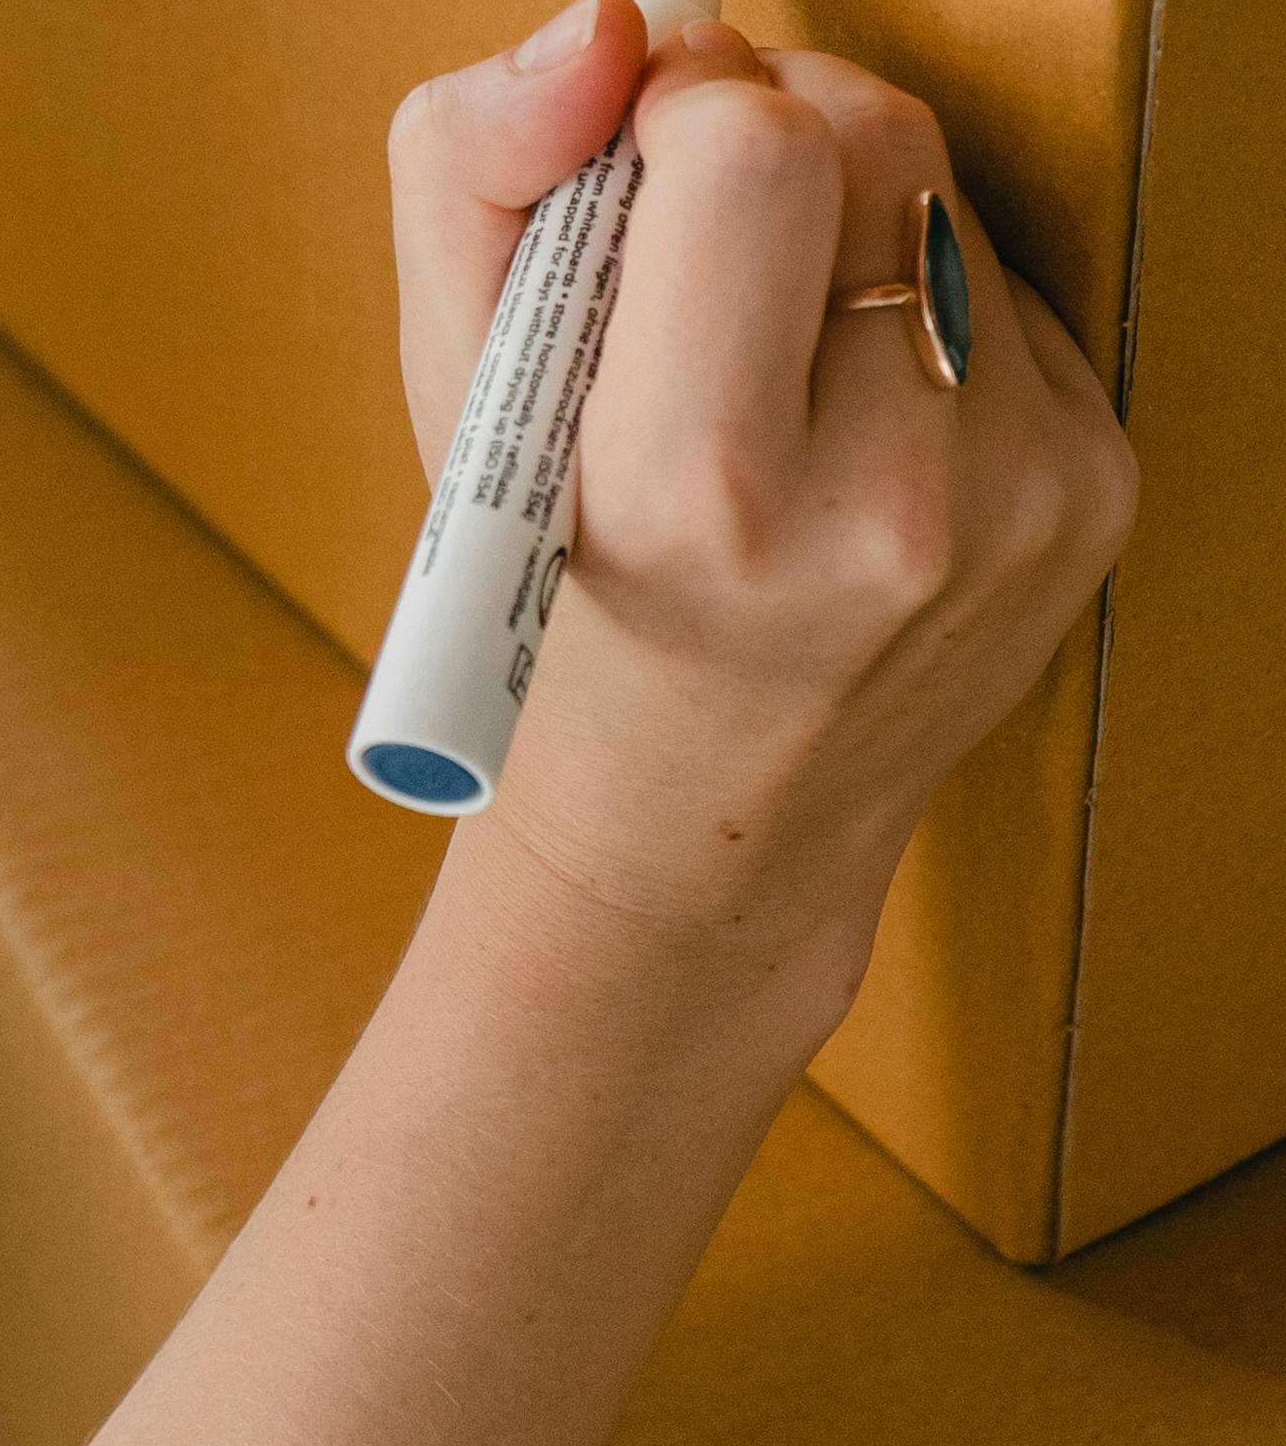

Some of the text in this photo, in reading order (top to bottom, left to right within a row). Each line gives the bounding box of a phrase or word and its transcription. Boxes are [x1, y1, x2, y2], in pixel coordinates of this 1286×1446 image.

[591, 160, 615, 197] from
[556, 170, 589, 243] uncapped
[549, 244, 567, 267] for
[562, 199, 600, 289] whiteboards
[535, 270, 560, 303] days
[518, 304, 547, 363] without
[544, 302, 567, 340] store
[578, 306, 601, 344] ohne
[499, 365, 528, 414] drying
[513, 341, 555, 429] horizontally
[492, 414, 510, 437] up
[471, 472, 494, 505] 554)
